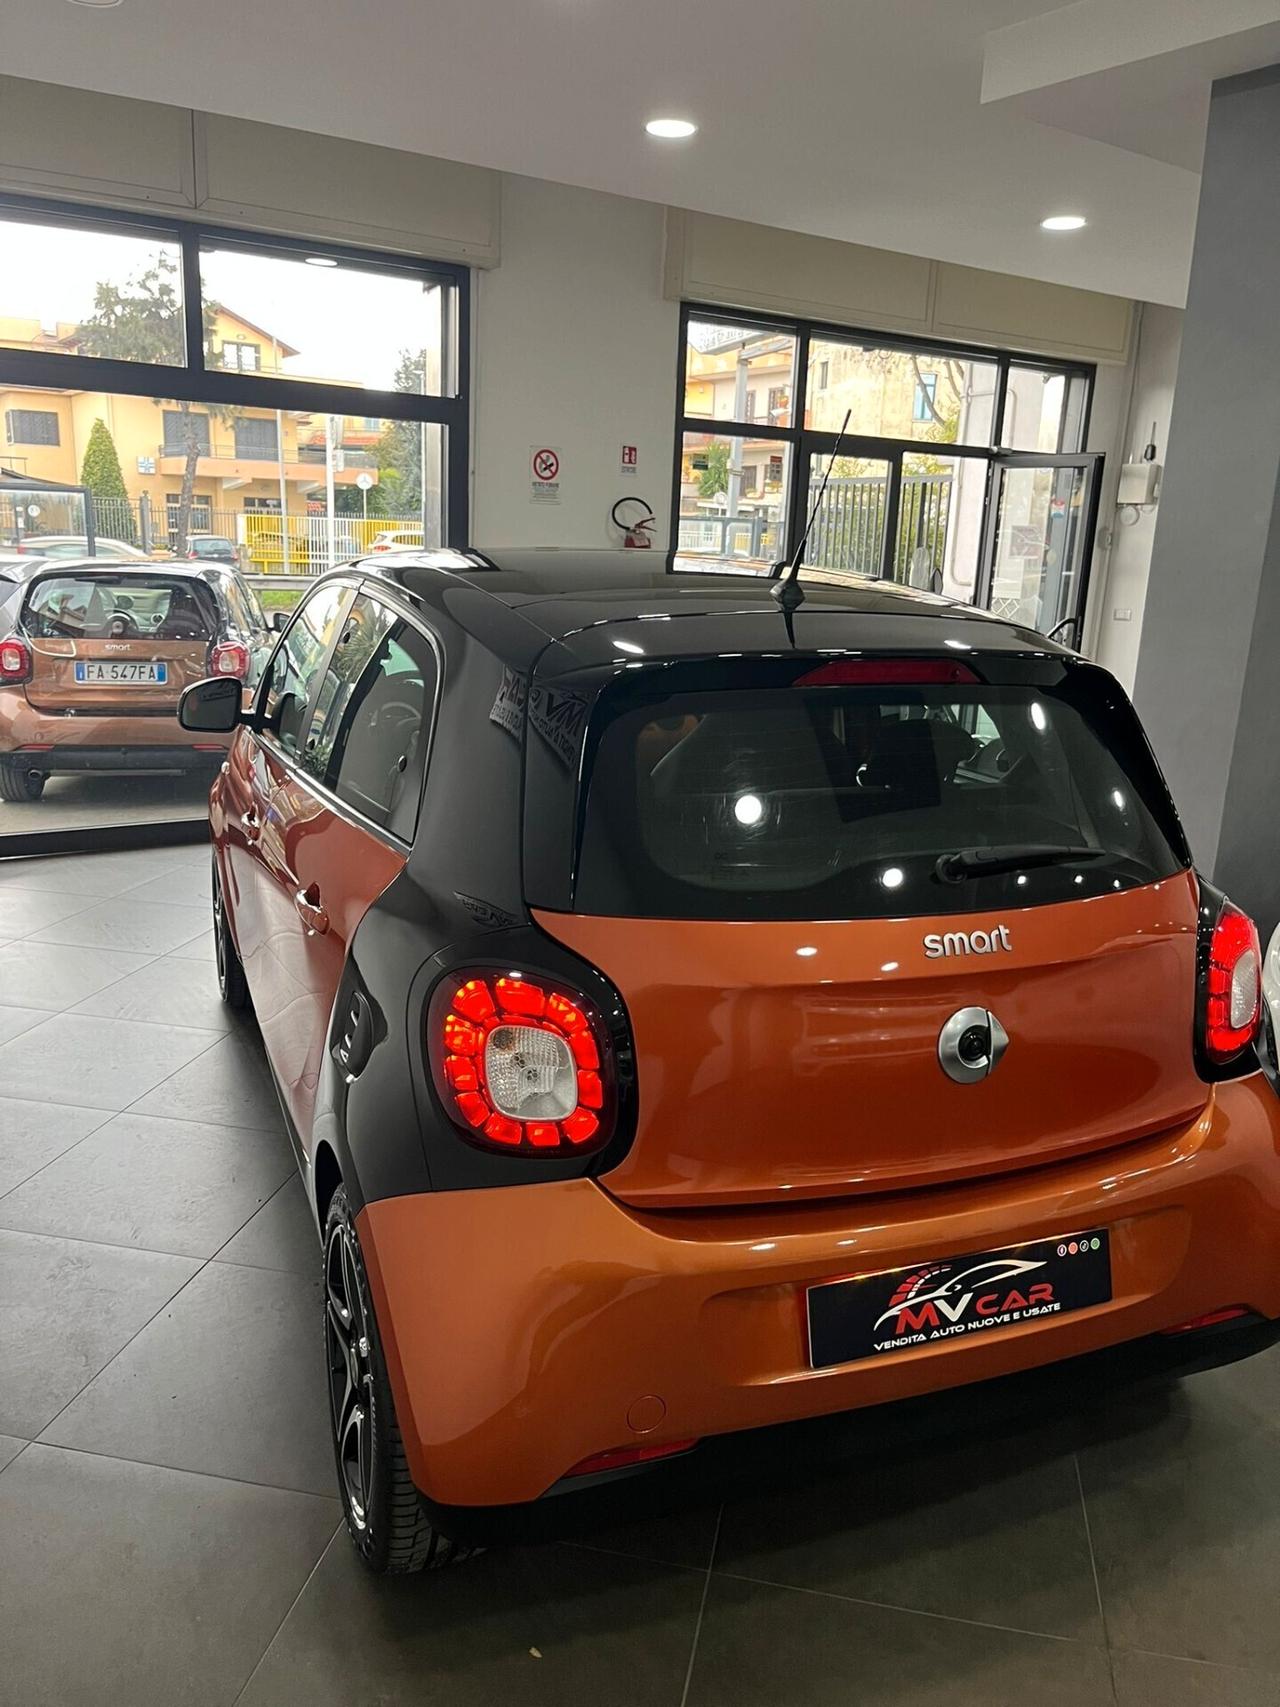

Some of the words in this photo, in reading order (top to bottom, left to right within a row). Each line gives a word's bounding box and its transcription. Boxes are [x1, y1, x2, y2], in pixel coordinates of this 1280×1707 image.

[923, 924, 1012, 959] smart
[873, 1333, 927, 1350] VENDITA
[930, 1324, 966, 1339] AUTO
[967, 1313, 1011, 1330] NUOVE
[1012, 1310, 1021, 1321] E
[1022, 1302, 1062, 1318] USATE
[895, 1292, 974, 1335] MV
[975, 1283, 1056, 1316] CAR
